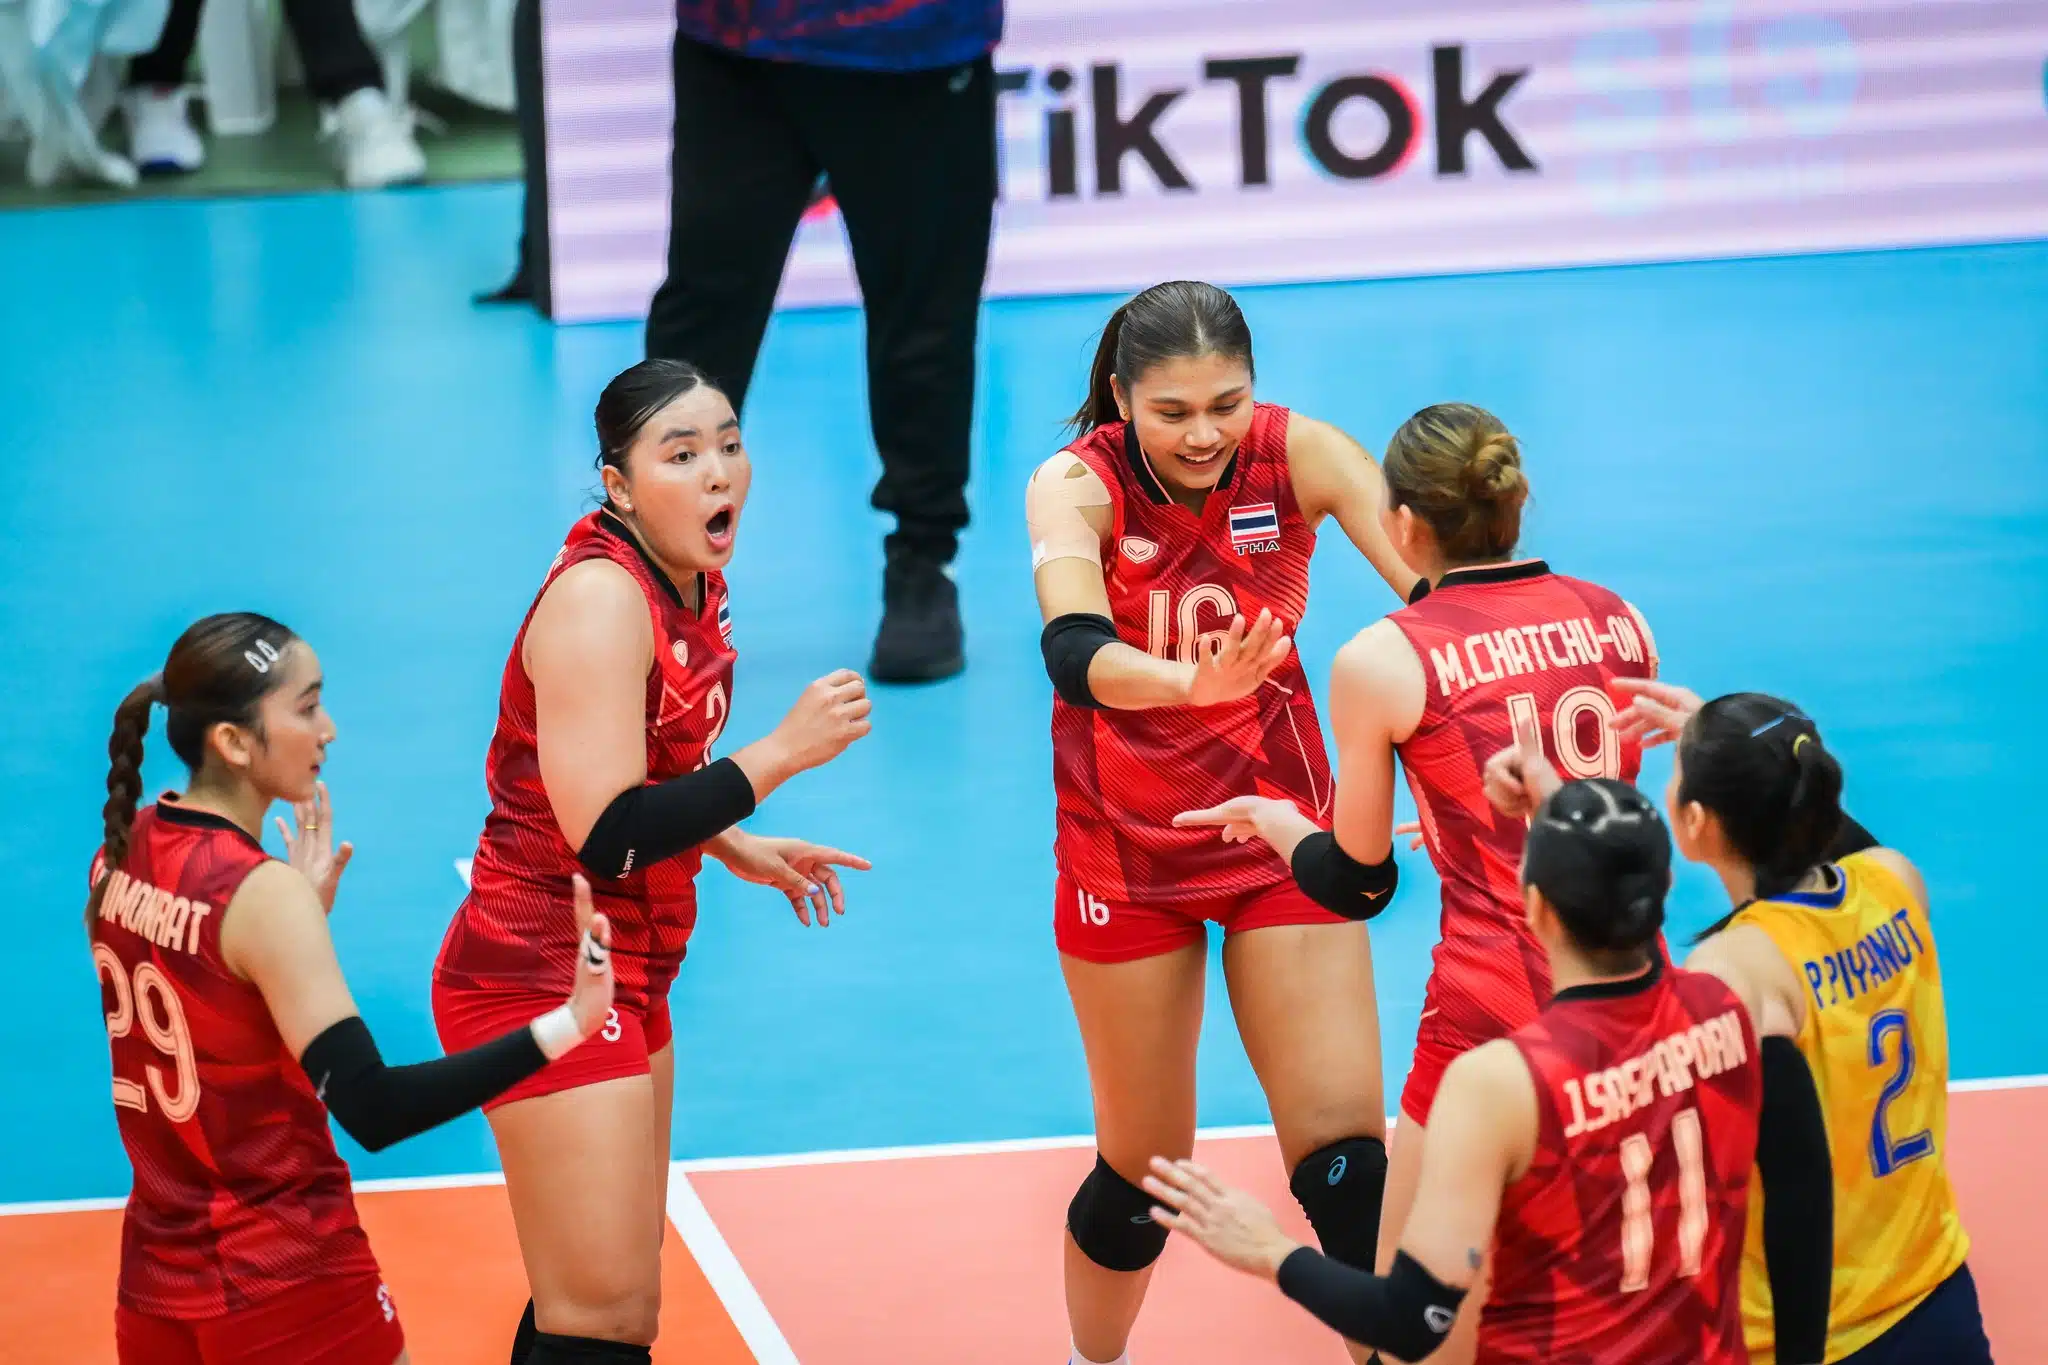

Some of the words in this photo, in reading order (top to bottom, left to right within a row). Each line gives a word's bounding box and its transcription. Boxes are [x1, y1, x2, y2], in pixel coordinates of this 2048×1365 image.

[1233, 540, 1280, 556] THA
[1147, 583, 1238, 665] 16
[1430, 615, 1644, 696] M.CHATCHU-ON
[1077, 887, 1110, 926] 16
[91, 942, 201, 1122] 29
[601, 1006, 621, 1042] 3
[1867, 1008, 1936, 1179] 2
[1619, 1106, 1709, 1293] 11
